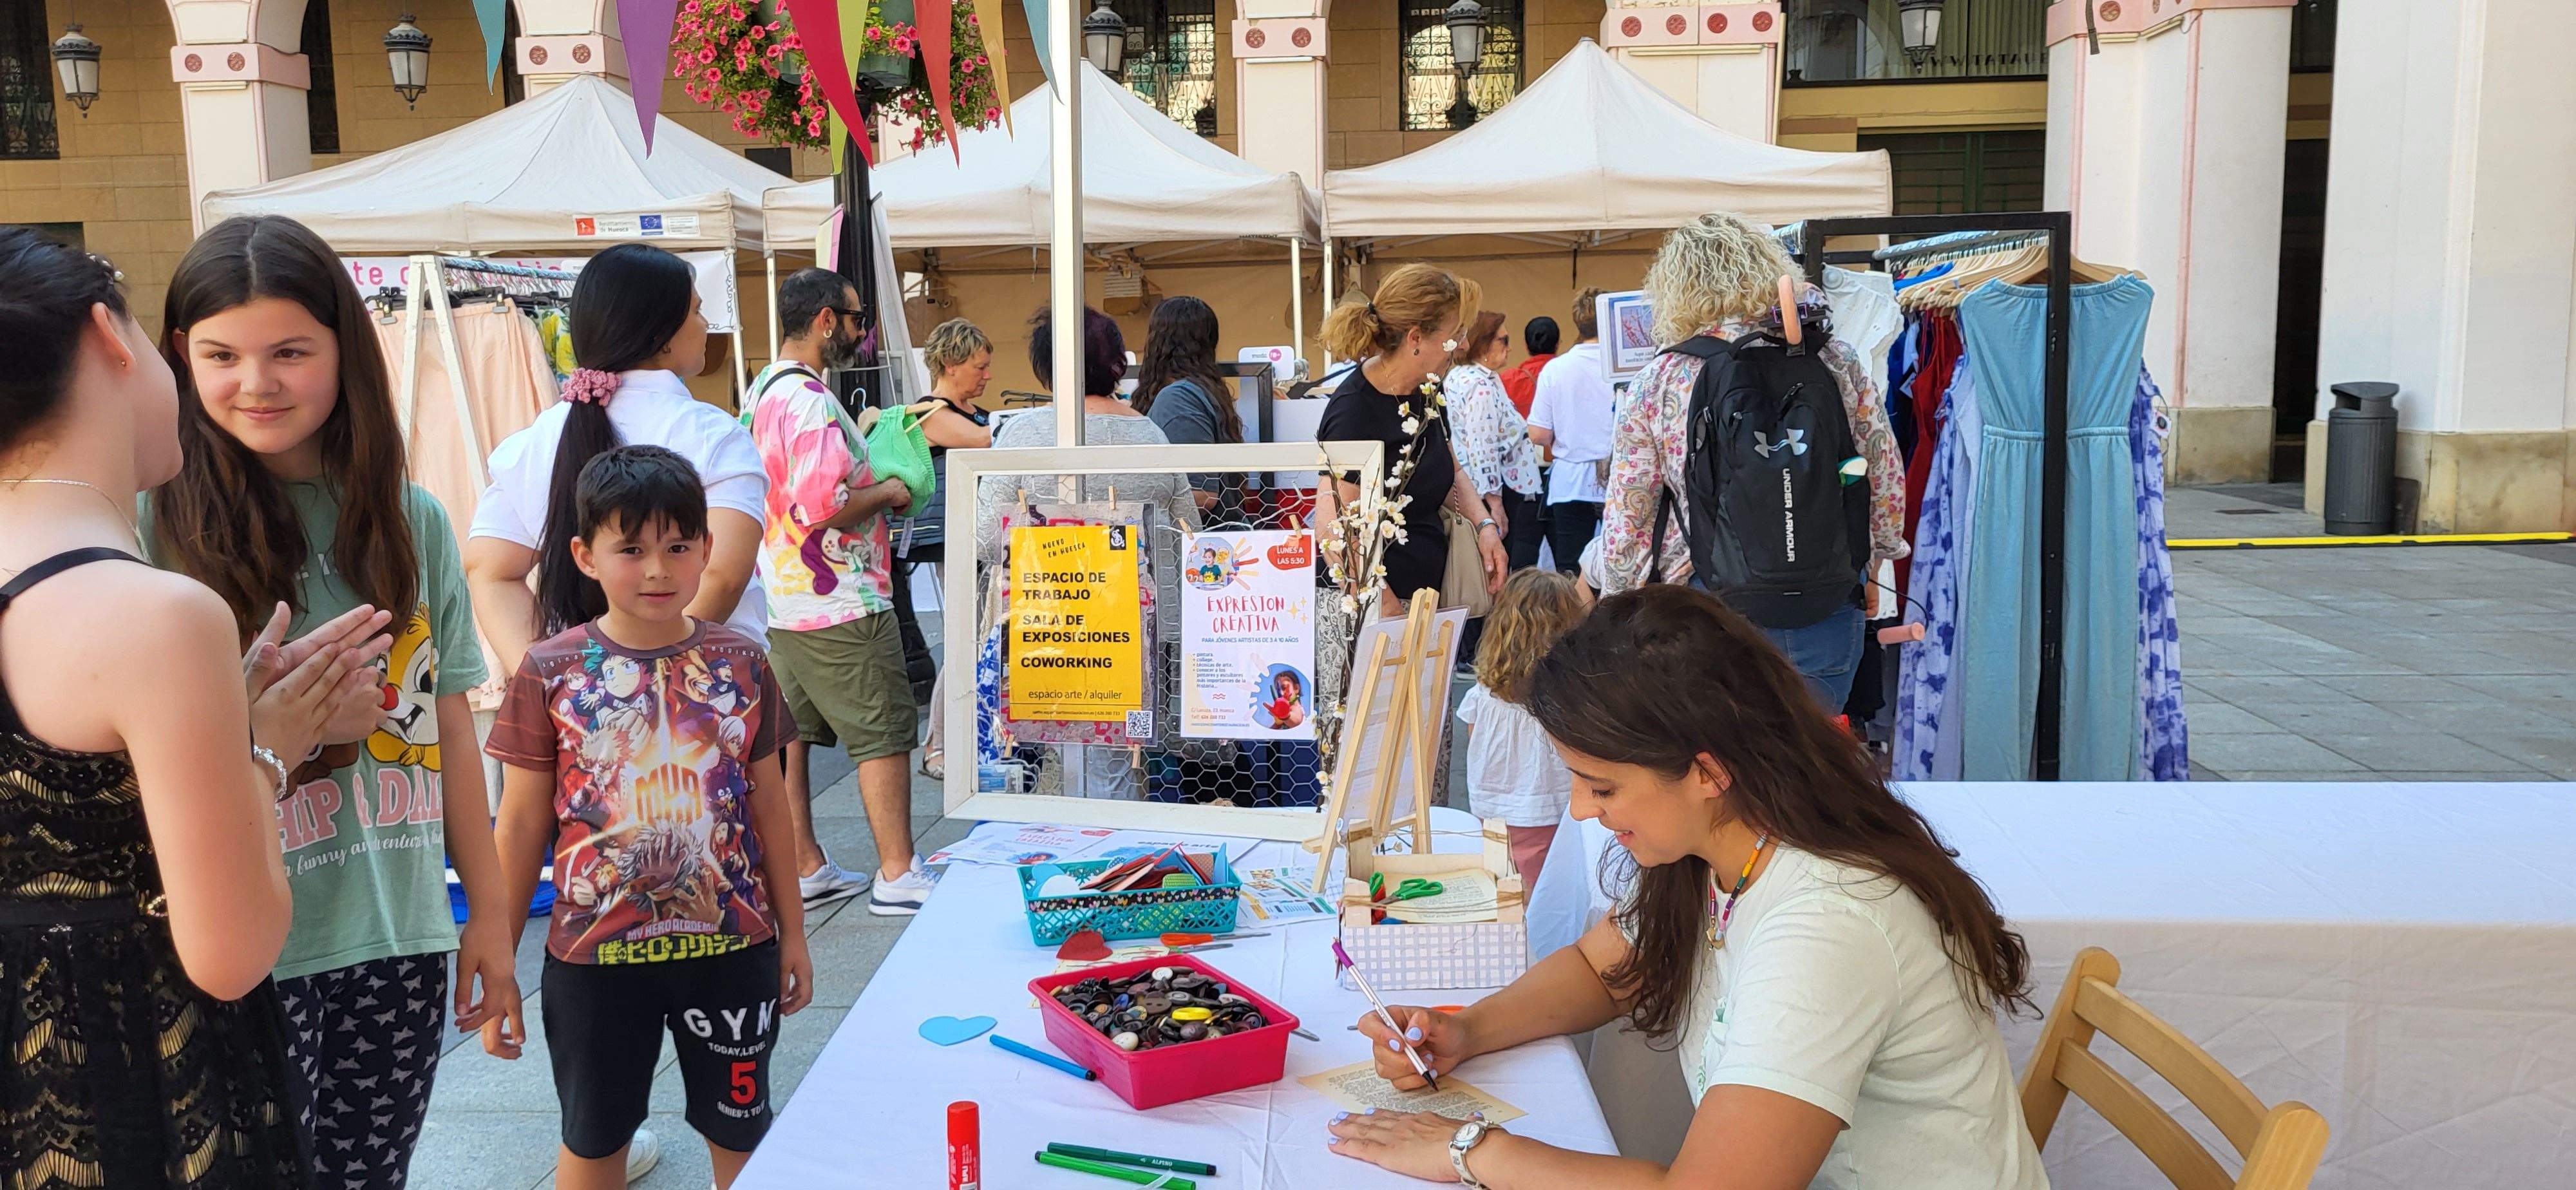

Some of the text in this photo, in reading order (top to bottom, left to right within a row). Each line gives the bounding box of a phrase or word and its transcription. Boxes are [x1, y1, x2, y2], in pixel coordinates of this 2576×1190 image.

[1782, 468, 1795, 562] UNDER ARMOUR
[1042, 538, 1065, 549] NUEVO
[1060, 542, 1086, 555] HUESCA
[1276, 546, 1297, 554] LUNES
[1023, 572, 1106, 583] ESPACIO DE
[1023, 589, 1091, 600] TRABAJO
[1207, 595, 1285, 614] EXPRESION
[1023, 614, 1084, 626] SALA DE
[1212, 614, 1280, 633] CREATIVA
[1023, 632, 1130, 643] EXPOSICIONES
[1021, 657, 1113, 668] COWORKING
[1028, 689, 1122, 701] espacio arte / alquiler
[296, 849, 347, 876] funny
[627, 929, 643, 941] MY
[645, 921, 672, 938] HERO
[730, 1060, 757, 1105] 5
